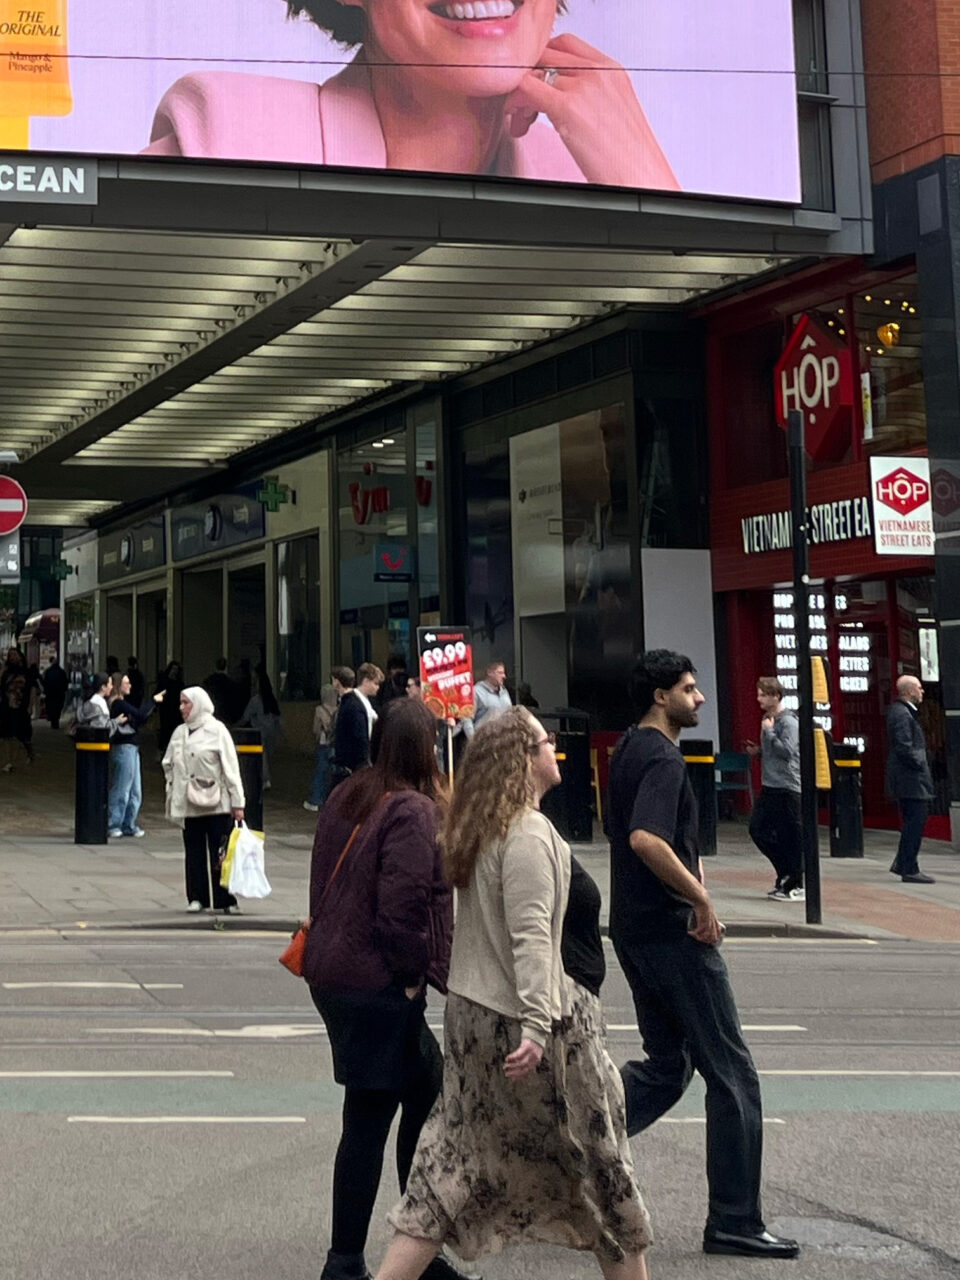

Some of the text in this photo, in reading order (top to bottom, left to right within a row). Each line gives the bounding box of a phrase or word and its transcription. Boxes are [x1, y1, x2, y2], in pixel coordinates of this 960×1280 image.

[17, 10, 45, 23] THE
[0, 22, 62, 38] ORIGINAL
[9, 51, 41, 65] Mango
[8, 61, 53, 73] Pineapple
[811, 499, 852, 545] STREET
[879, 520, 932, 532] VIETNAMESE
[880, 534, 932, 548] STREET EATS
[422, 640, 467, 669] £9.99
